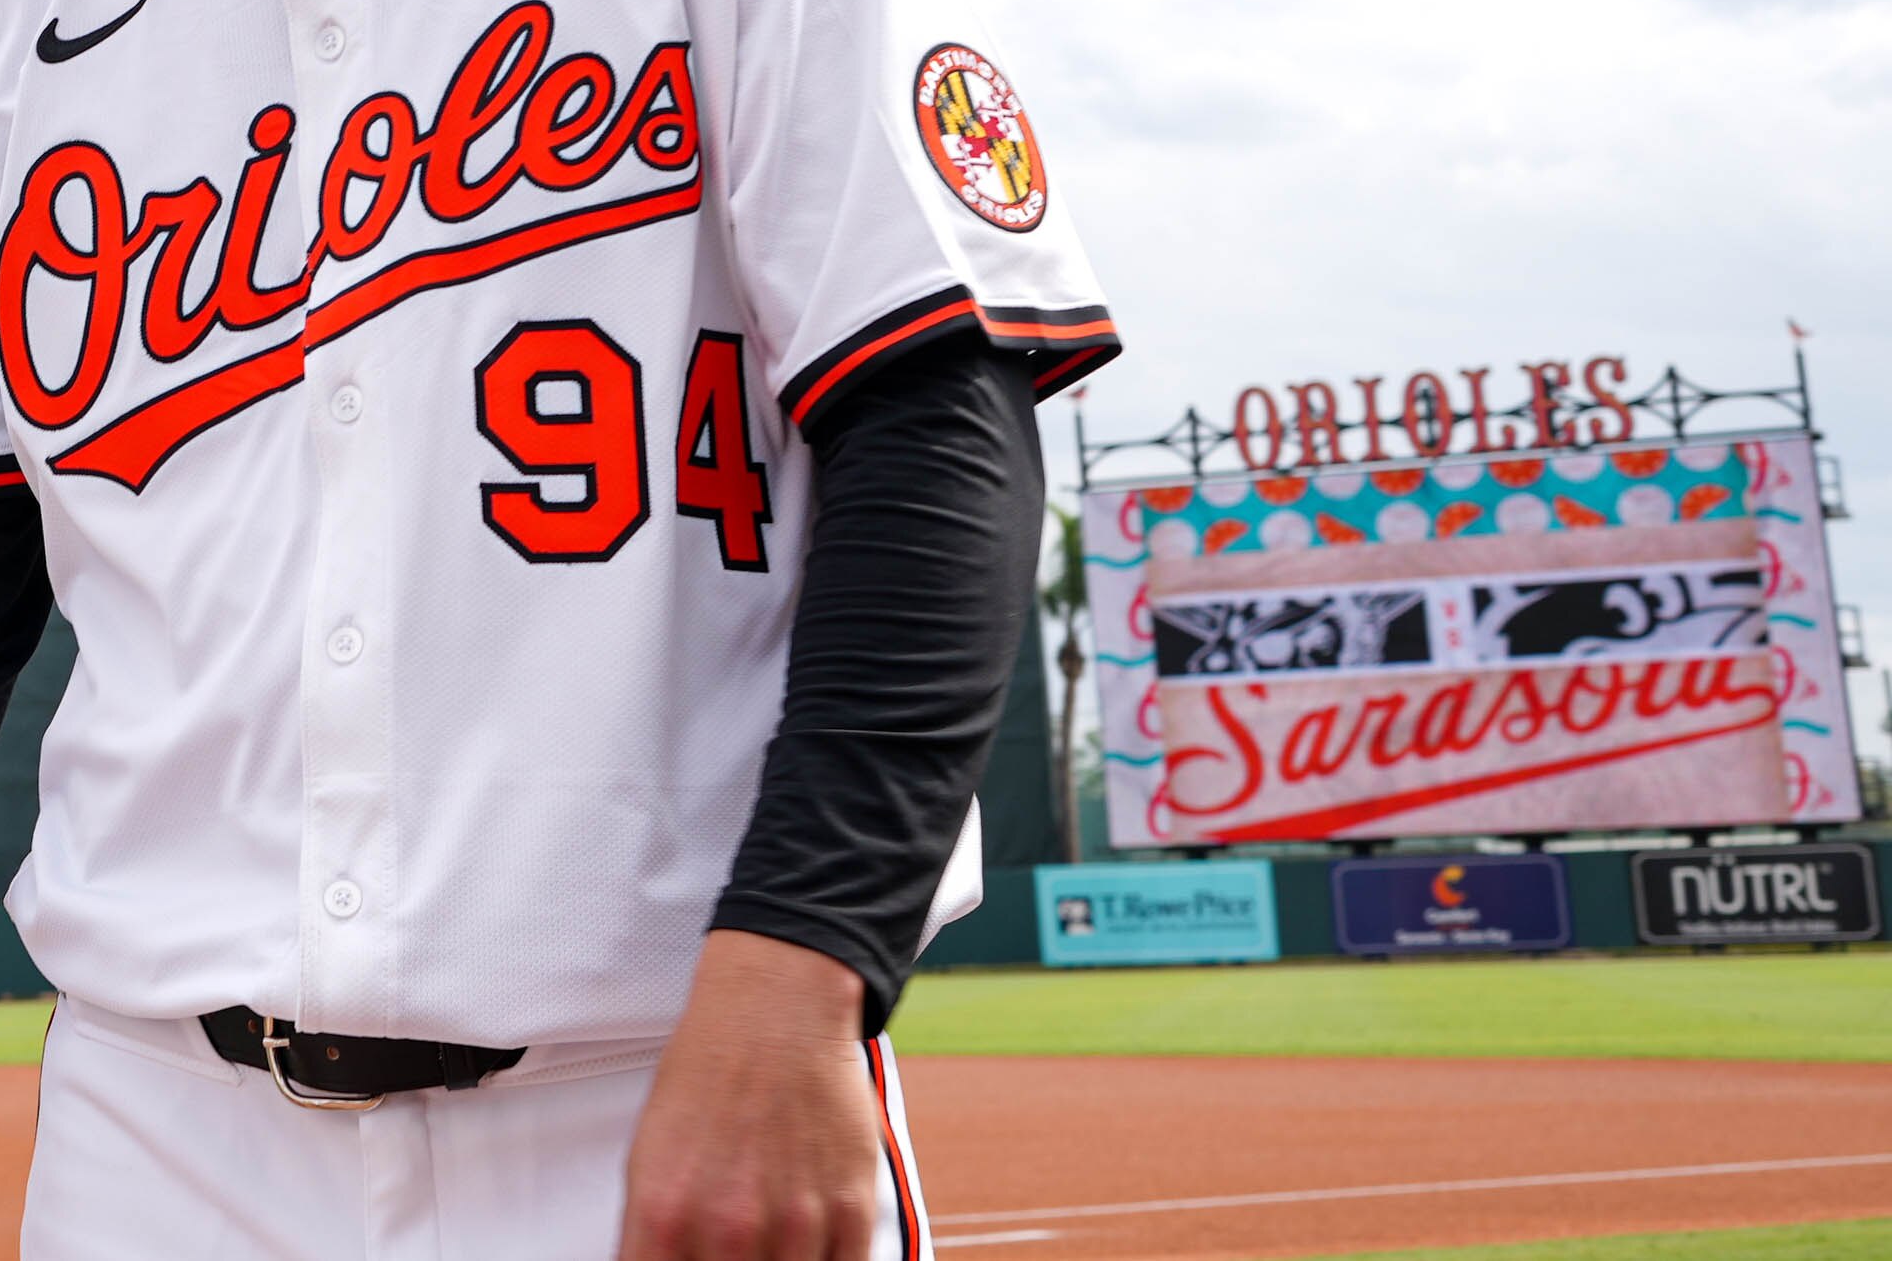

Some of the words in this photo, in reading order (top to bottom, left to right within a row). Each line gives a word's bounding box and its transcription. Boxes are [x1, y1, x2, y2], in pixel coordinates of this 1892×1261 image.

[919, 50, 1023, 116] BALTIMORE
[960, 183, 1046, 223] ORIOLES
[474, 318, 772, 572] 94
[1234, 356, 1634, 471] ORIOLES
